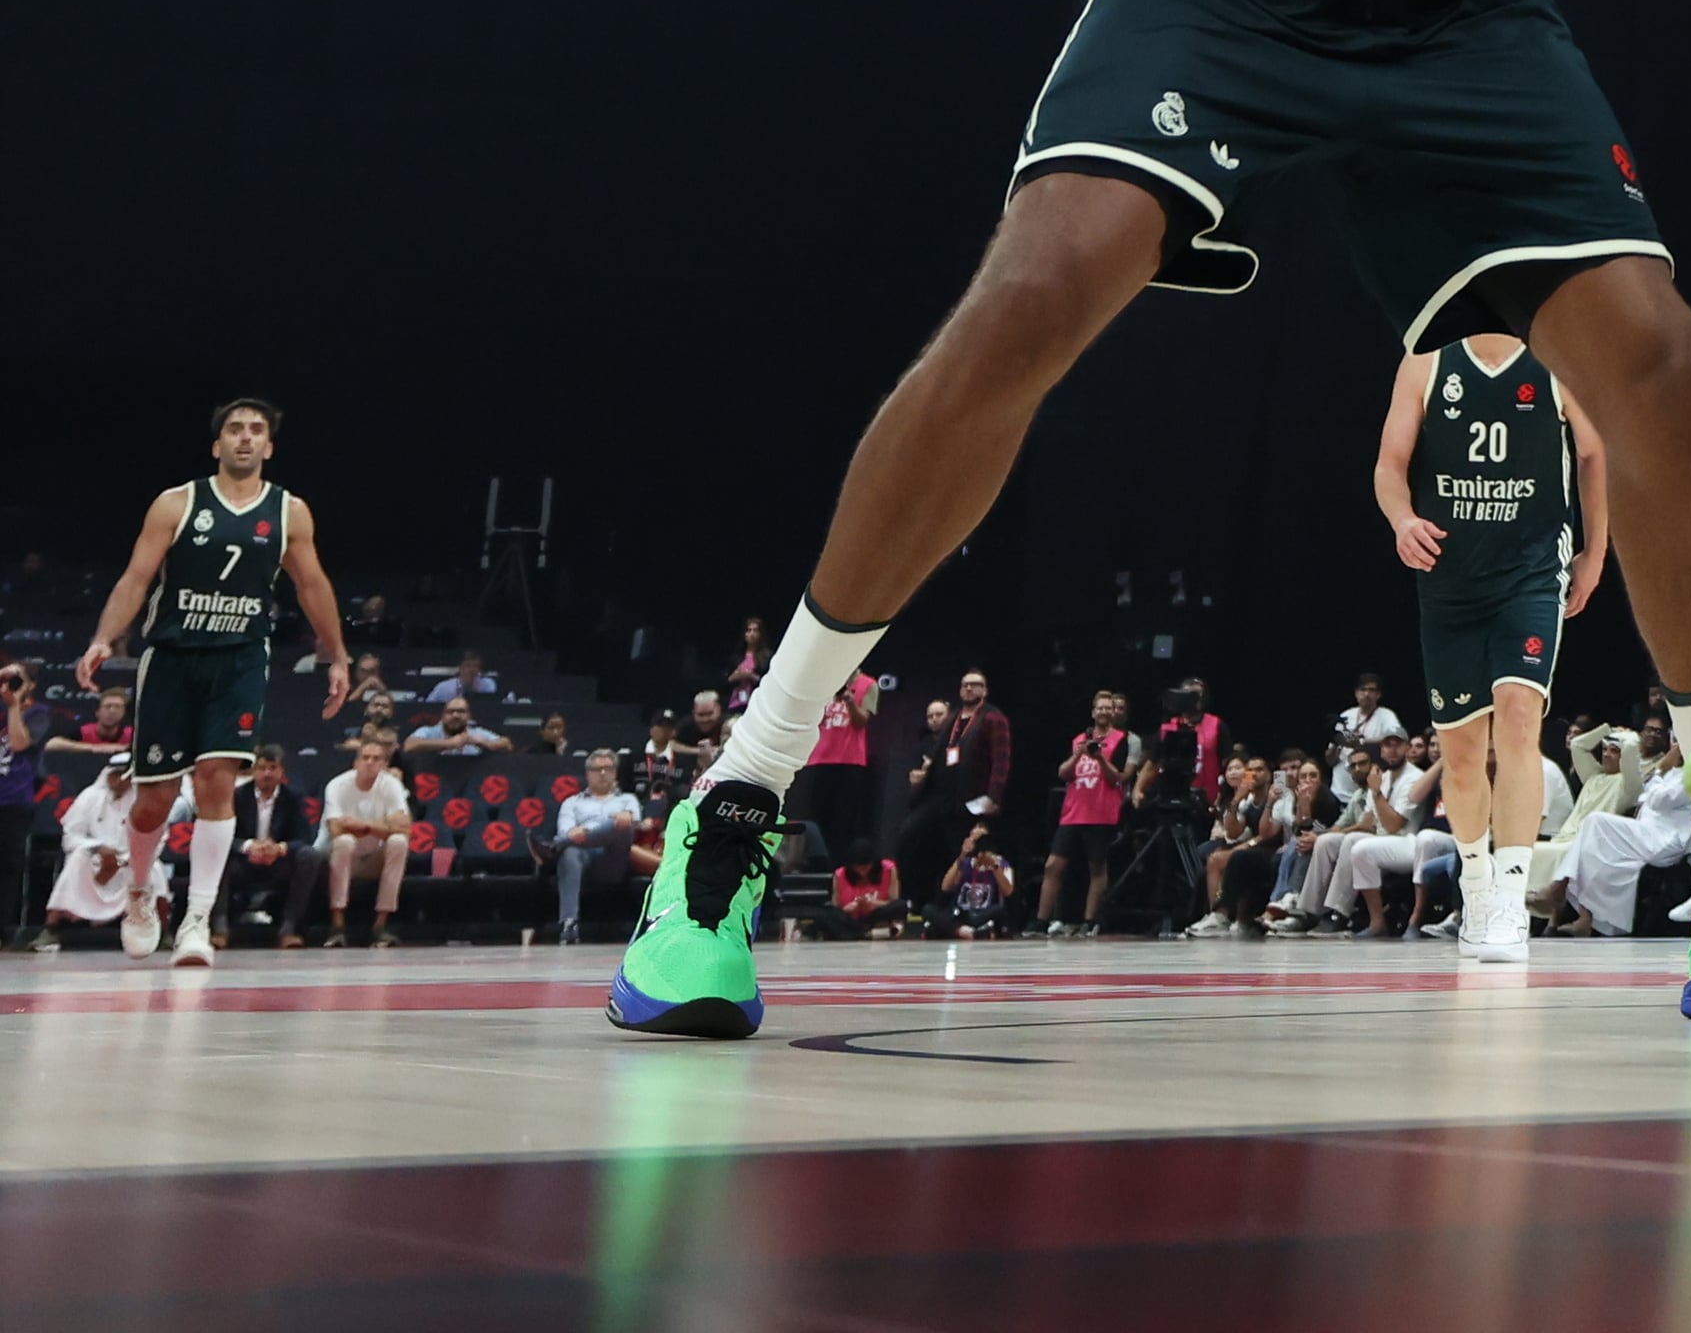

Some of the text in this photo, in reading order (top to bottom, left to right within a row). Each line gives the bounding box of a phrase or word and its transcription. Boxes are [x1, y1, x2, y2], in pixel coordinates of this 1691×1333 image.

[1468, 421, 1507, 463] 20
[1435, 474, 1536, 500] Emirates
[1452, 500, 1520, 522] FLY BETTER
[219, 544, 242, 581] 7
[177, 588, 262, 615] Emirates
[182, 611, 251, 633] FLY BETTER
